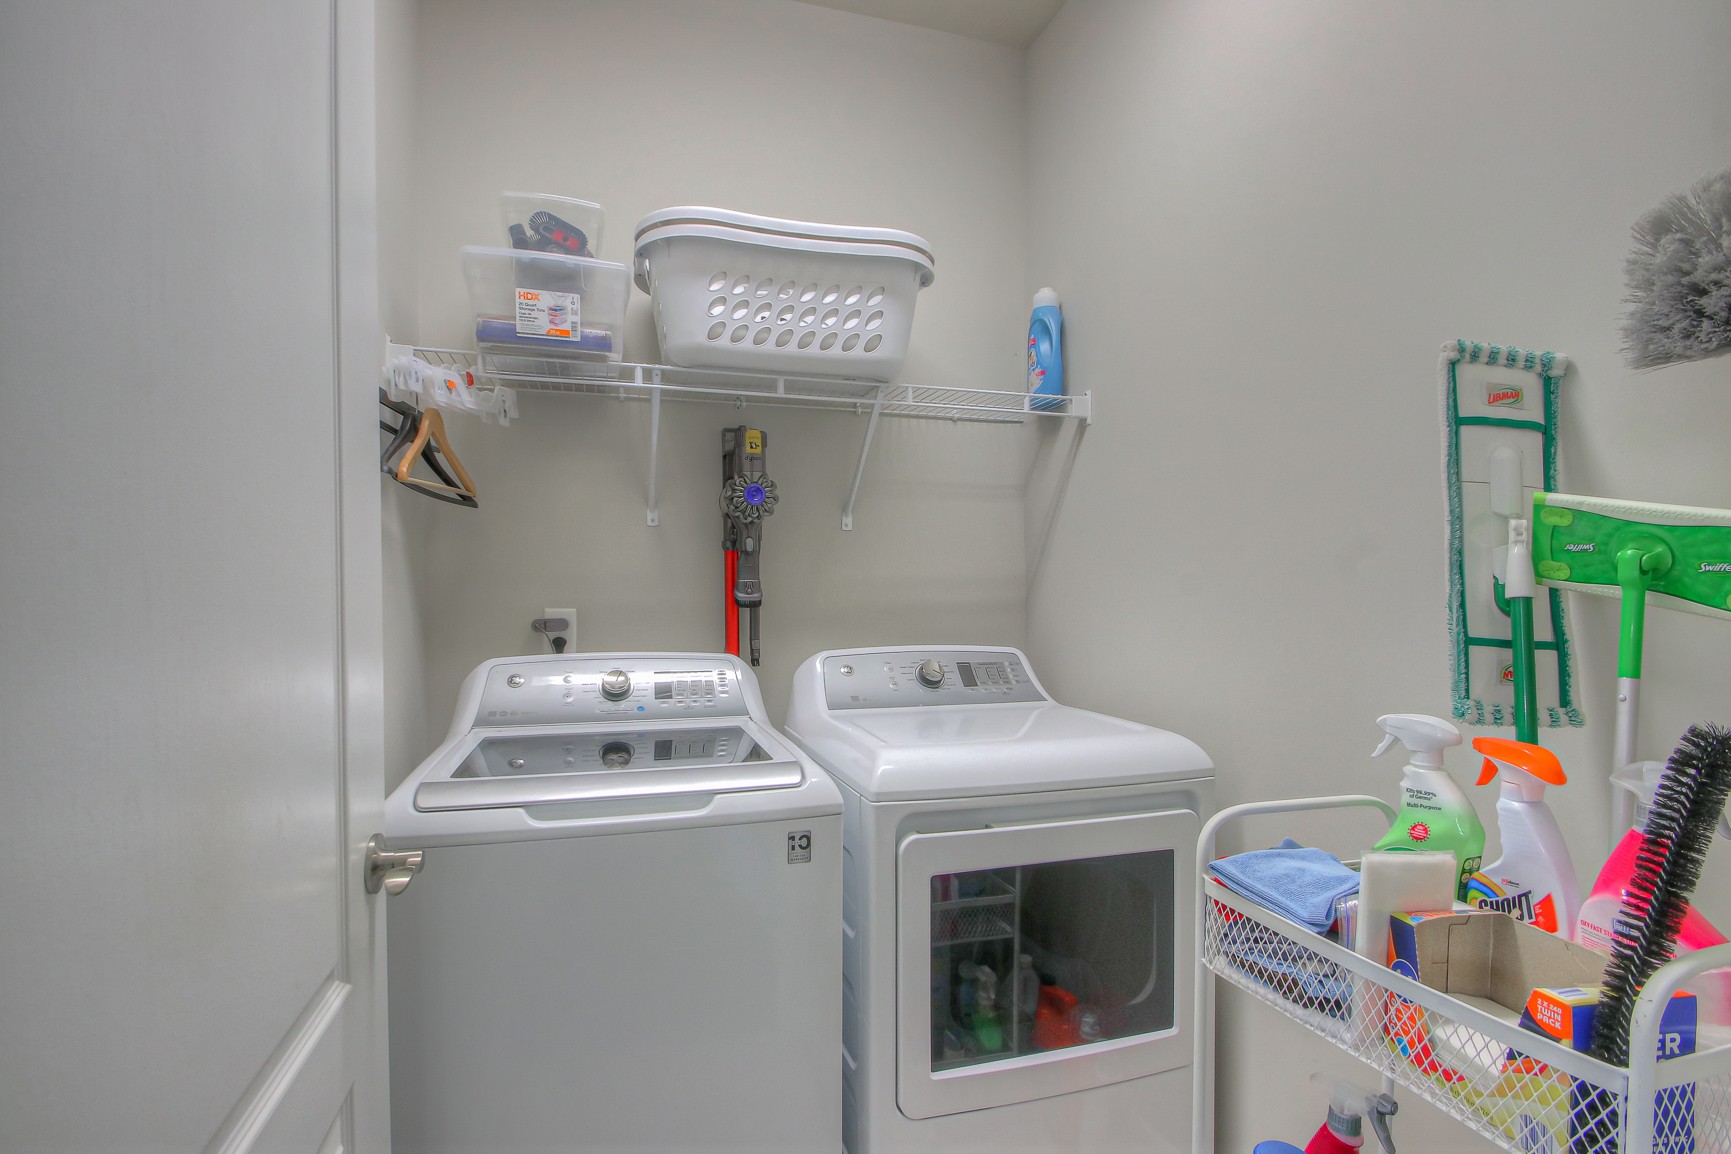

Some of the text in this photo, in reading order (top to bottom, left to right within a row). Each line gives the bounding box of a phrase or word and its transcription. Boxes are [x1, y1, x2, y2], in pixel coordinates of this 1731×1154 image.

[518, 291, 541, 301] HDX
[1487, 391, 1520, 405] LIBMAN
[1564, 543, 1596, 552] Swiffer
[1406, 802, 1441, 811] Multi-Purpose
[1537, 1004, 1561, 1022] TWIN
[1537, 1012, 1563, 1030] PACK
